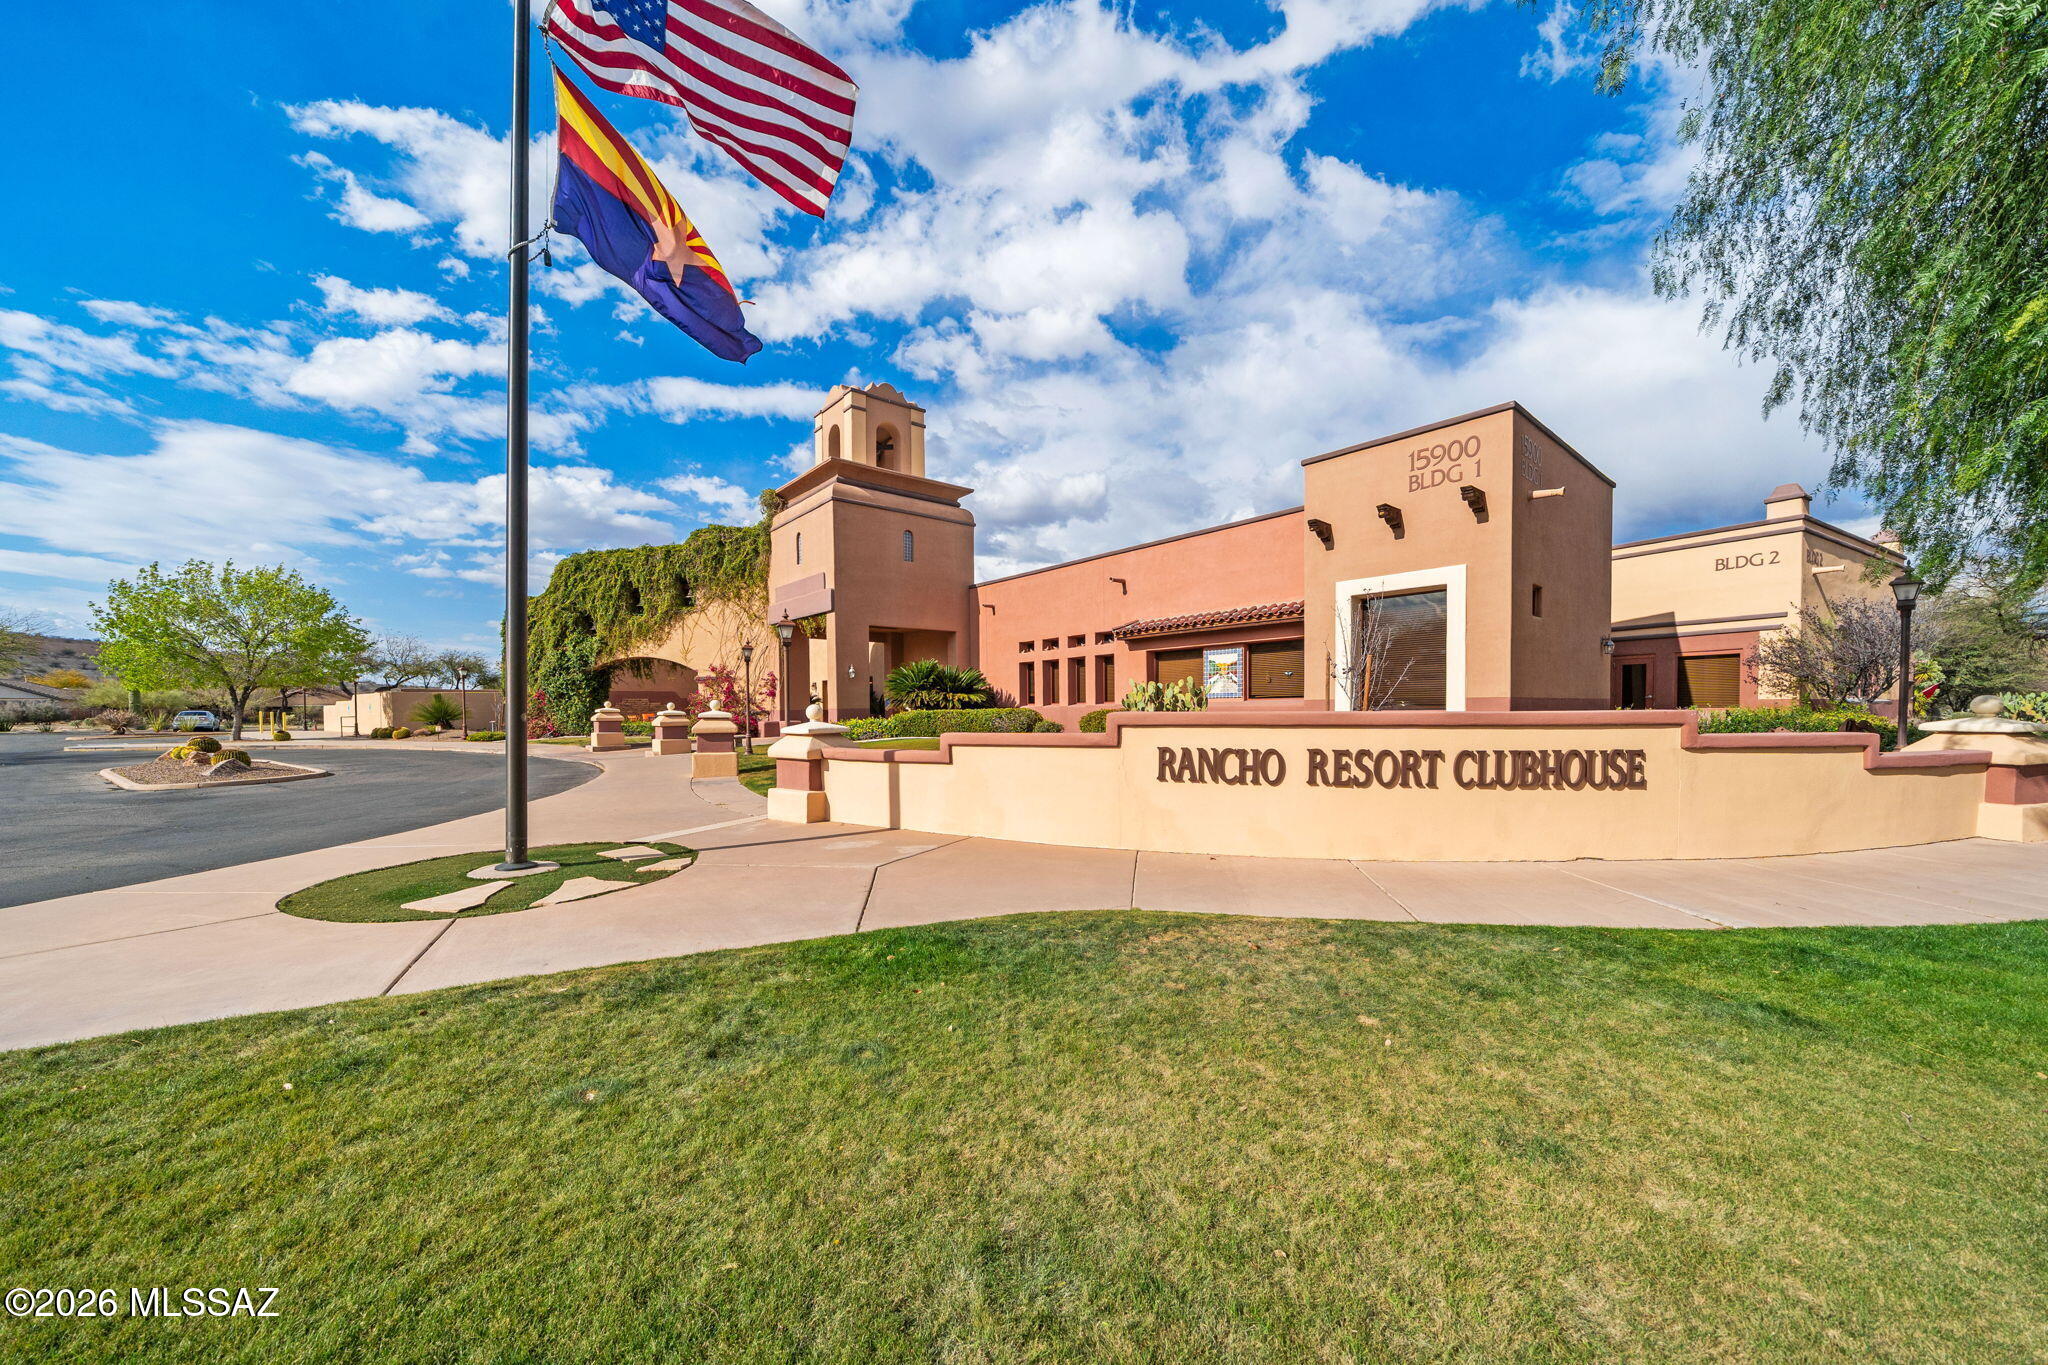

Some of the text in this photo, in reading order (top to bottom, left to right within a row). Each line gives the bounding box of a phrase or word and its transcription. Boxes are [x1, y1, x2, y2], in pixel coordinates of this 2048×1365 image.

[1408, 435, 1481, 472] 15900
[1408, 459, 1481, 493] BLDG 1
[1715, 551, 1780, 571] BLDG 2
[1157, 746, 1647, 791] RANCHO RESORT CLUBHOUSE
